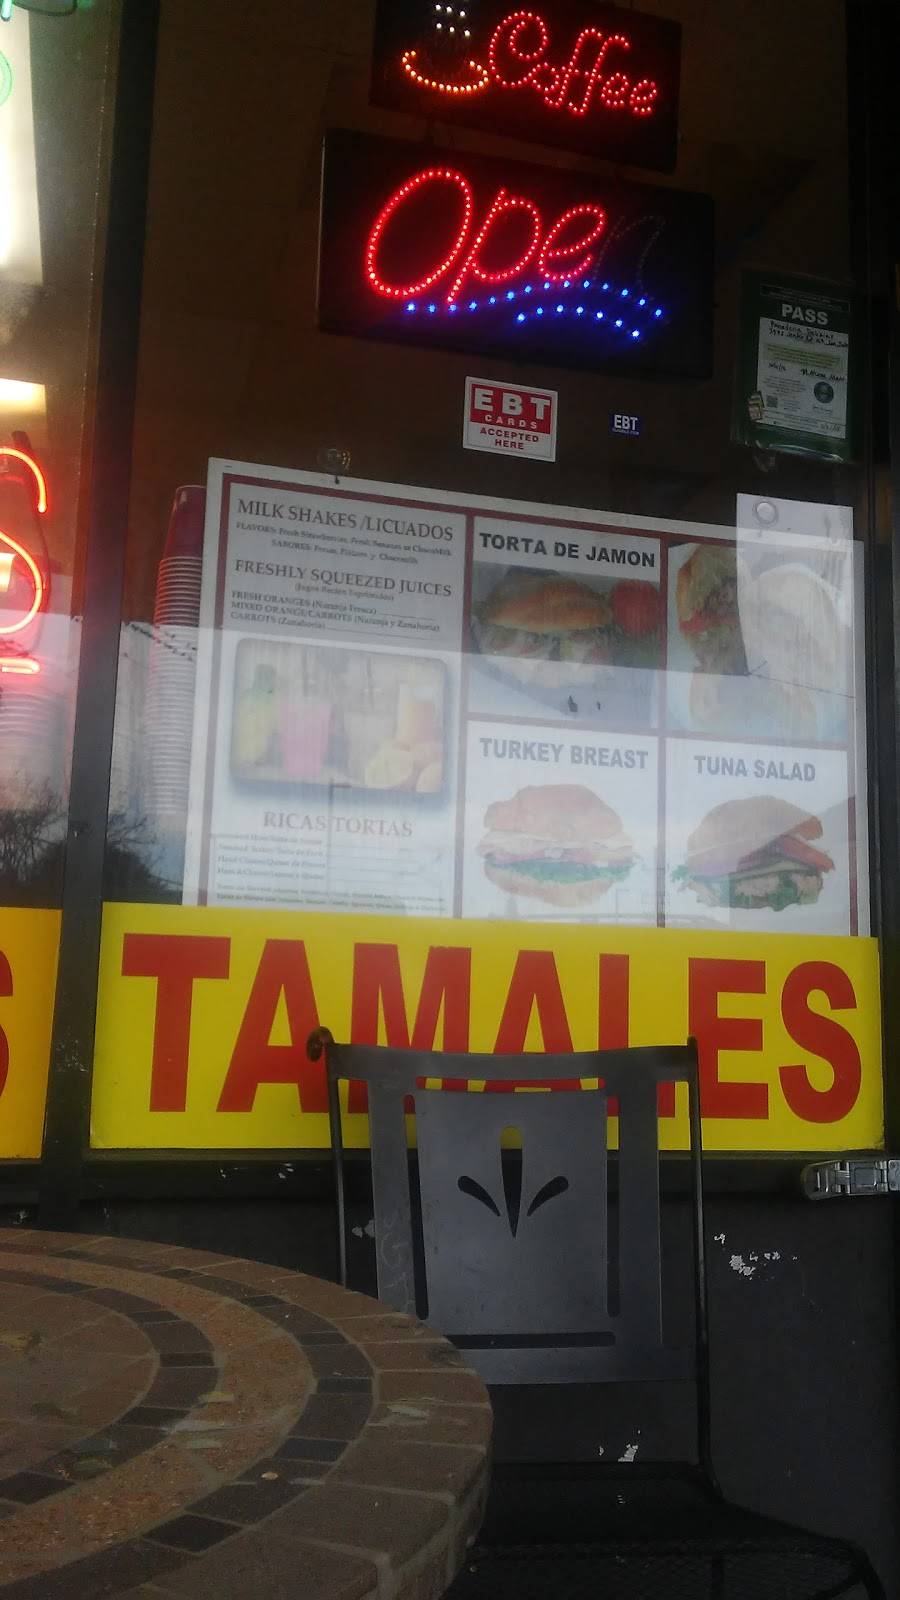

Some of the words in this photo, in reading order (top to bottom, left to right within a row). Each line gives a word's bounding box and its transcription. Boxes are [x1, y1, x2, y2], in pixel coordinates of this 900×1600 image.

[489, 8, 658, 115] Coffee
[365, 166, 667, 304] Open
[782, 303, 829, 326] PASS
[474, 388, 551, 420] EBT
[480, 427, 539, 443] ACCEPTED
[485, 415, 537, 429] CARDS
[614, 414, 638, 431] EBT
[495, 439, 525, 450] HERE
[237, 498, 286, 519] MILK
[288, 506, 358, 528] SHAKES
[479, 532, 547, 556] TORTA
[554, 542, 579, 559] DE
[586, 547, 656, 568] JAMON
[235, 559, 305, 580] FRESHLY
[310, 569, 396, 590] SQUEEZED
[399, 579, 452, 598] JUICES
[230, 611, 277, 624] CARROTS
[480, 737, 564, 764] TURKEY
[570, 745, 649, 770] BREAST
[693, 754, 748, 778] TUNA
[753, 759, 816, 783] SALAD
[263, 810, 328, 832] RICAS
[335, 816, 413, 838] TORTAS
[122, 931, 862, 1125] TAMALES
